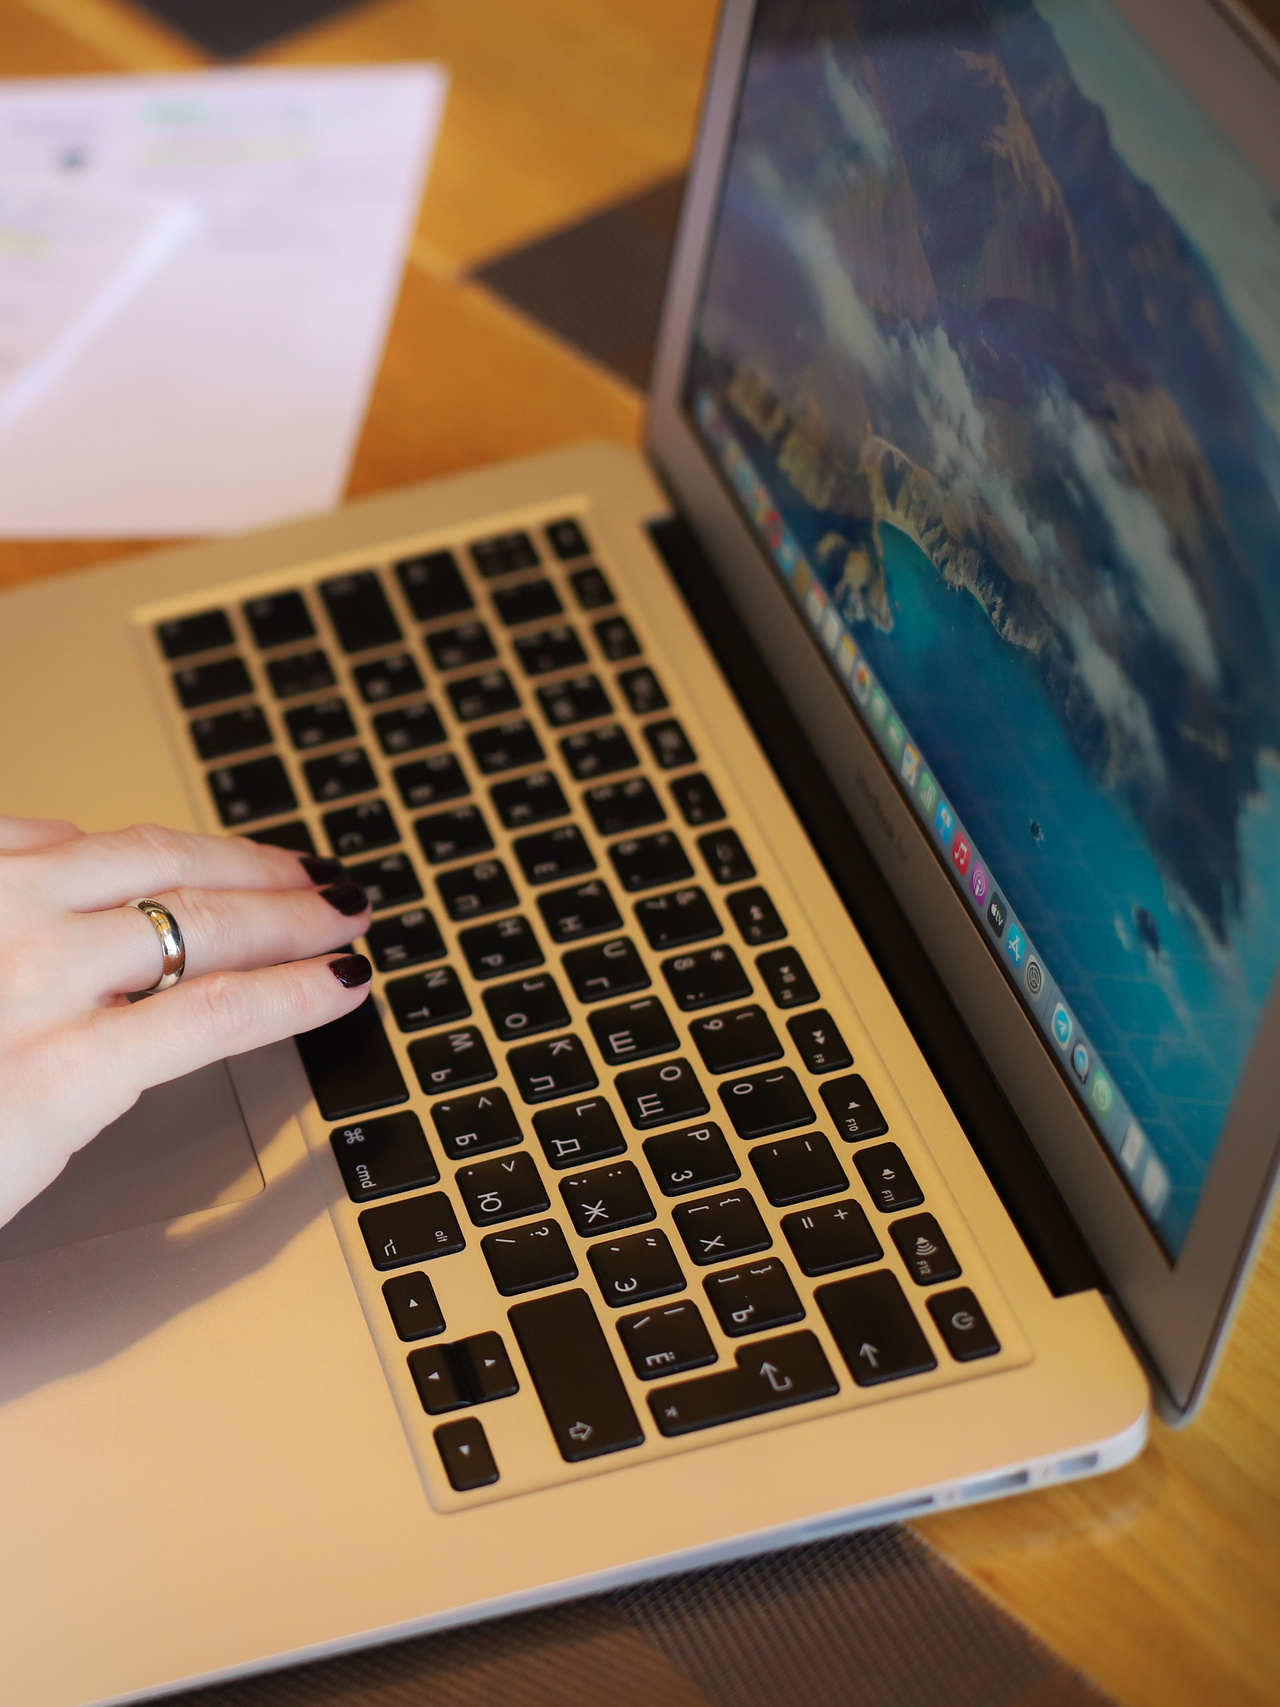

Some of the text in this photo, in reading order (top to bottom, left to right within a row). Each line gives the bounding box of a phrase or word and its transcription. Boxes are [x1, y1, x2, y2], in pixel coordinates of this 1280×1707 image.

[602, 940, 626, 958] U
[672, 957, 695, 971] 8
[423, 969, 447, 988] N
[521, 980, 545, 992] J
[702, 1018, 724, 1031] 9
[448, 1032, 473, 1052] M
[548, 1038, 572, 1056] K
[607, 1029, 636, 1054] Ш
[812, 1052, 825, 1064] F9
[429, 1067, 451, 1082] Ь
[528, 1074, 555, 1092] Л
[731, 1082, 753, 1095] 0
[574, 1101, 597, 1117] L
[636, 1092, 664, 1118] Щ
[844, 1117, 859, 1132] F10
[454, 1132, 478, 1146] Б
[686, 1128, 710, 1141] P
[550, 1137, 581, 1157] Д
[500, 1159, 515, 1173] >
[354, 1163, 377, 1189] cmd
[476, 1190, 502, 1213] Ю
[718, 1197, 741, 1207] {
[880, 1188, 895, 1202] F11
[580, 1199, 609, 1223] Ж
[686, 1204, 710, 1214] [
[832, 1208, 848, 1220] +
[800, 1215, 814, 1229] =
[433, 1229, 448, 1243] alt
[528, 1226, 549, 1237] ?
[749, 1263, 772, 1275] }
[915, 1259, 931, 1275] F12
[613, 1276, 637, 1293] Э
[716, 1273, 740, 1283] ]
[730, 1303, 754, 1323] Ъ
[644, 1350, 675, 1366] Ё
